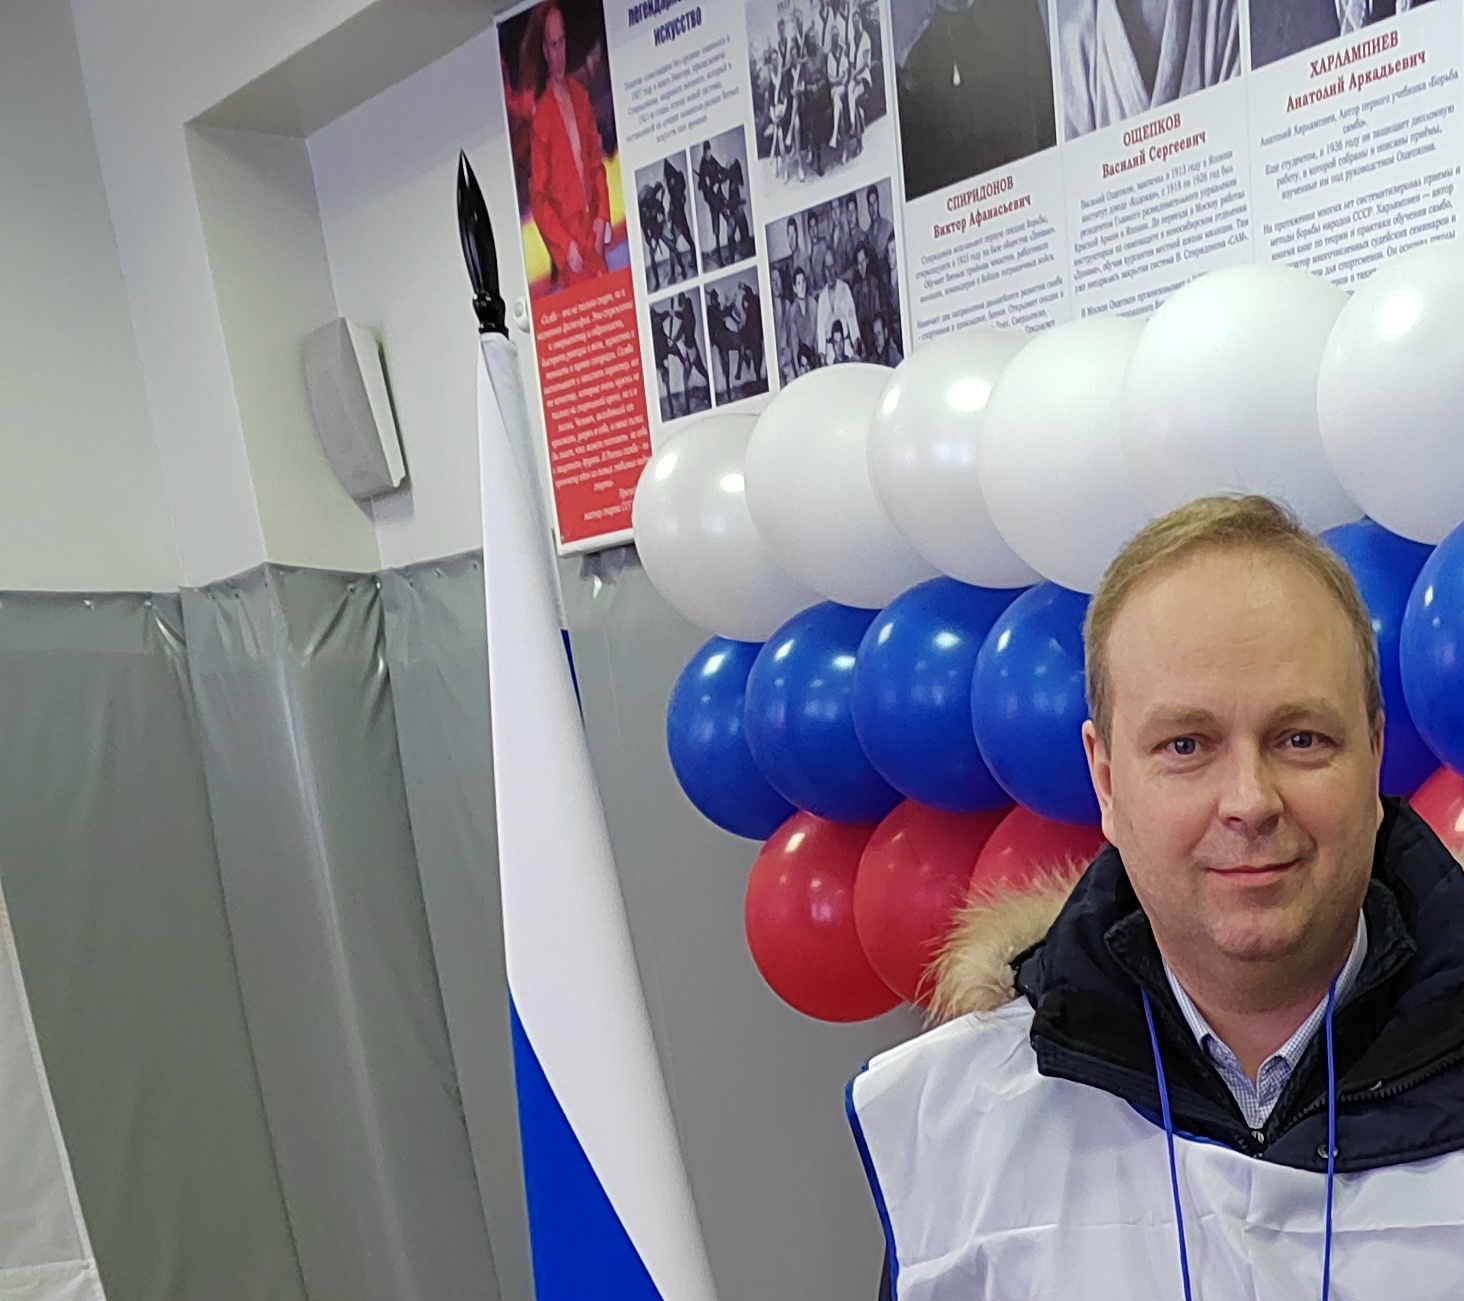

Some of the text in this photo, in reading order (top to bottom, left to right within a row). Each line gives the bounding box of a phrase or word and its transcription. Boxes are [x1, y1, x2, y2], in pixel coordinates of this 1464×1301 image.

[653, 6, 702, 47] искусство
[1310, 30, 1399, 78] ХАРЛАМПИЕВ
[1286, 50, 1426, 112] Анатолий Аркадьевич
[1123, 112, 1181, 146] ОЩЕПКОВ
[1102, 130, 1206, 178] Василий Сергеевич
[947, 175, 1014, 212] СПИРИДОНОВ
[934, 195, 1031, 239] Виктор Афанасьевич
